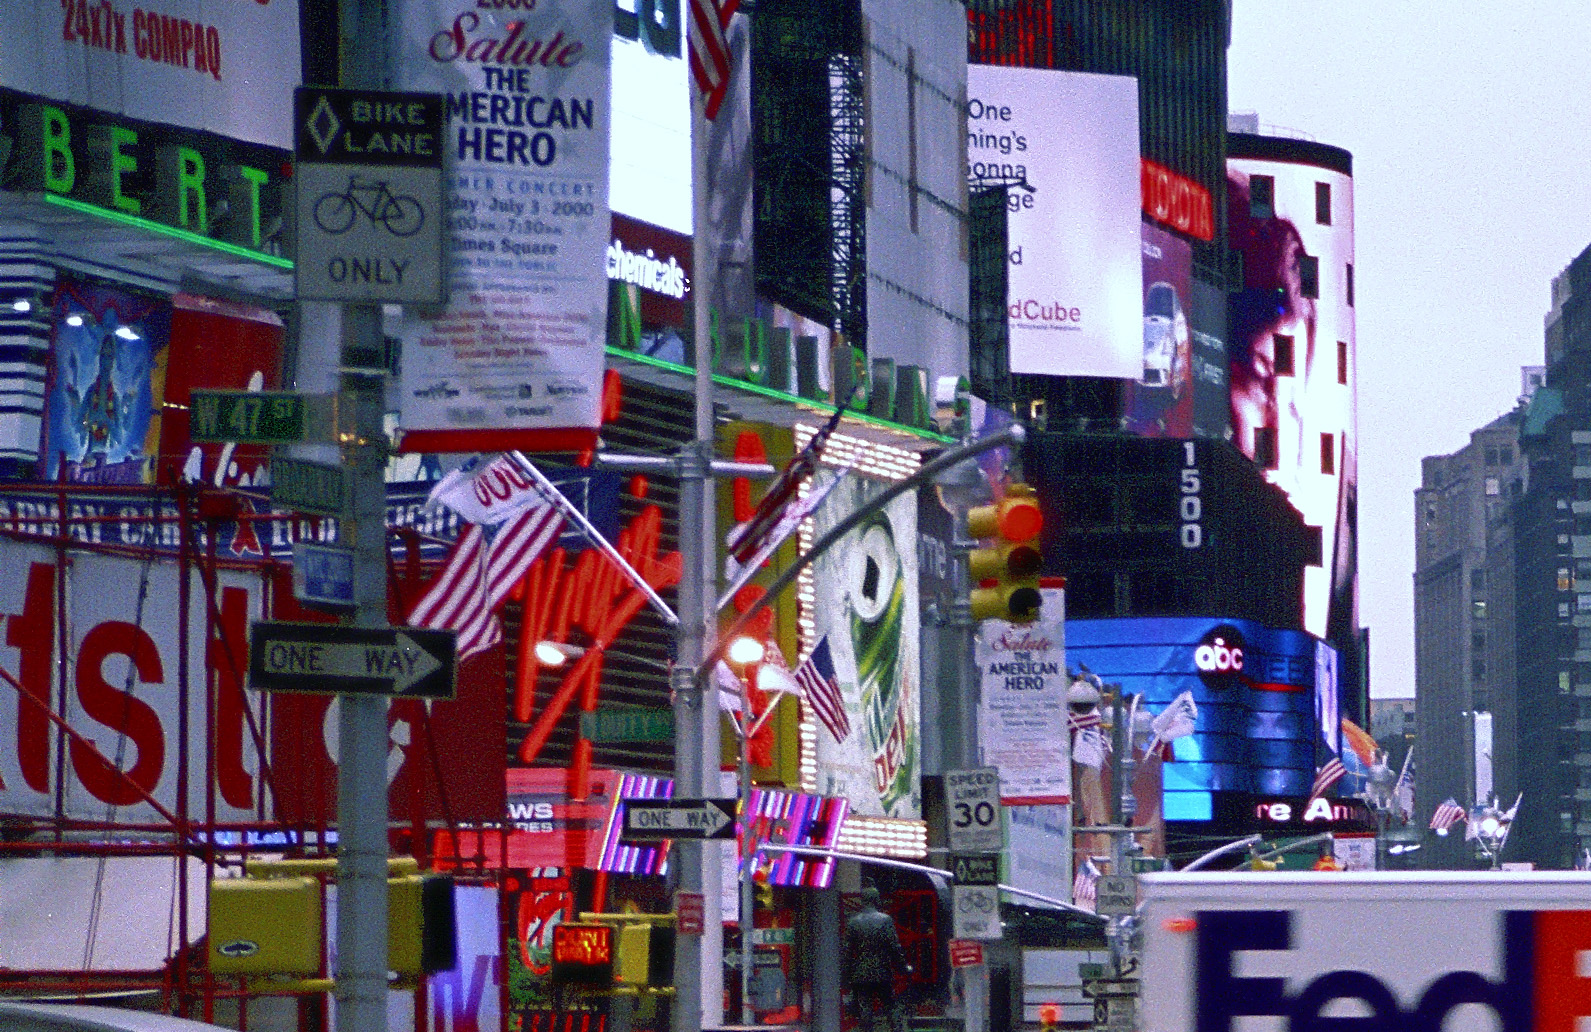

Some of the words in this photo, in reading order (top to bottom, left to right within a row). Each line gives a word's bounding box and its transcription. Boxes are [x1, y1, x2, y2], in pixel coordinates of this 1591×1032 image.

[132, 8, 222, 81] COMPAQ
[429, 11, 585, 68] Salute
[481, 66, 531, 94] THE
[351, 100, 427, 127] BIKE
[446, 91, 595, 130] MERICAN
[968, 98, 1012, 121] One
[343, 129, 433, 156] LANE
[457, 127, 557, 167] HERO
[44, 104, 270, 248] BERT
[488, 197, 524, 217] July
[552, 202, 595, 217] 2000
[501, 238, 559, 256] Square
[327, 257, 411, 286] ONLY
[605, 240, 686, 299] chemicals
[228, 397, 263, 436] 47
[269, 645, 324, 671] ONE
[364, 646, 422, 674] WAY
[989, 662, 1058, 676] AMERICAN
[1195, 640, 1243, 671] abc
[1005, 676, 1044, 691] HERO
[950, 773, 995, 786] SPEED
[955, 786, 988, 799] LIMIT
[637, 809, 671, 828] ONE
[686, 809, 722, 827] WAY
[953, 801, 995, 828] 30
[1106, 881, 1125, 893] NO
